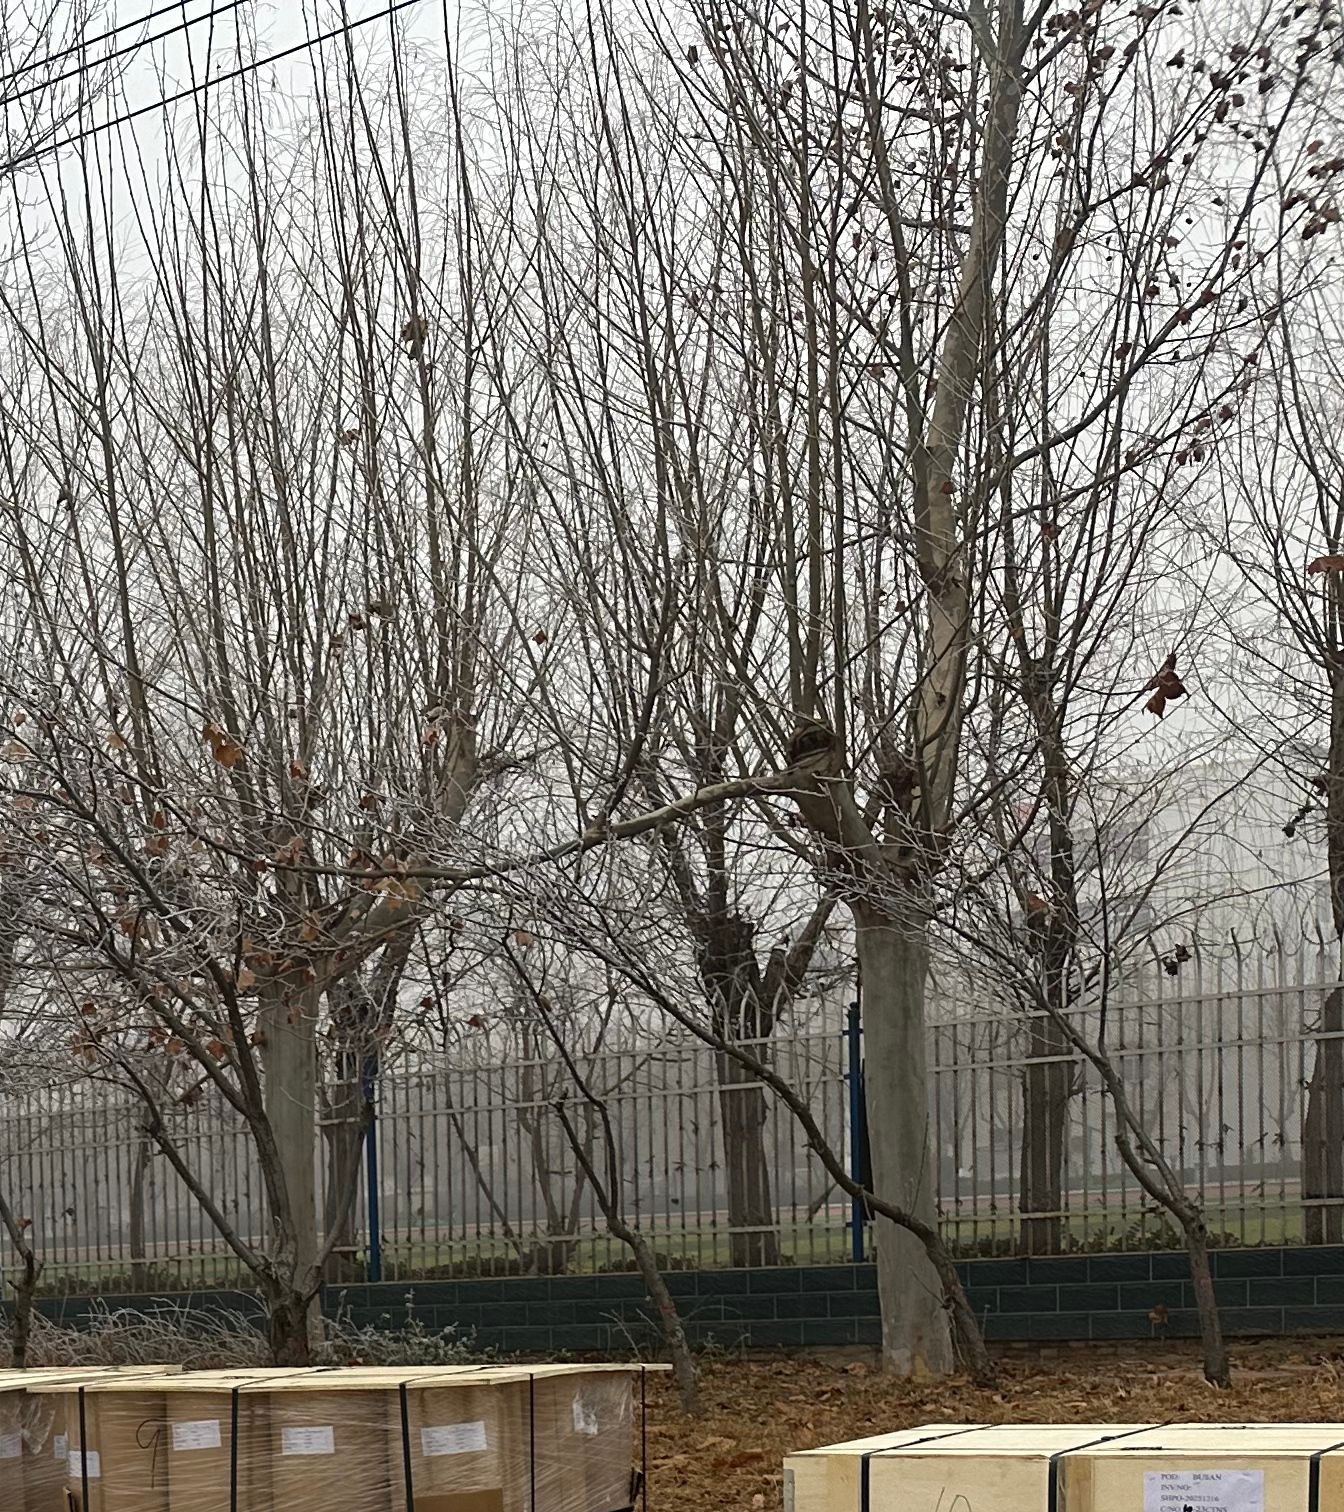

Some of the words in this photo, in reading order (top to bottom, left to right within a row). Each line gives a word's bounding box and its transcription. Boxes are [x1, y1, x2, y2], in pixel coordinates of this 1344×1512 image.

[135, 1417, 167, 1490] 9
[1192, 1473, 1223, 1481] BUSAN
[1160, 1494, 1220, 1502] SHPO-20251216
